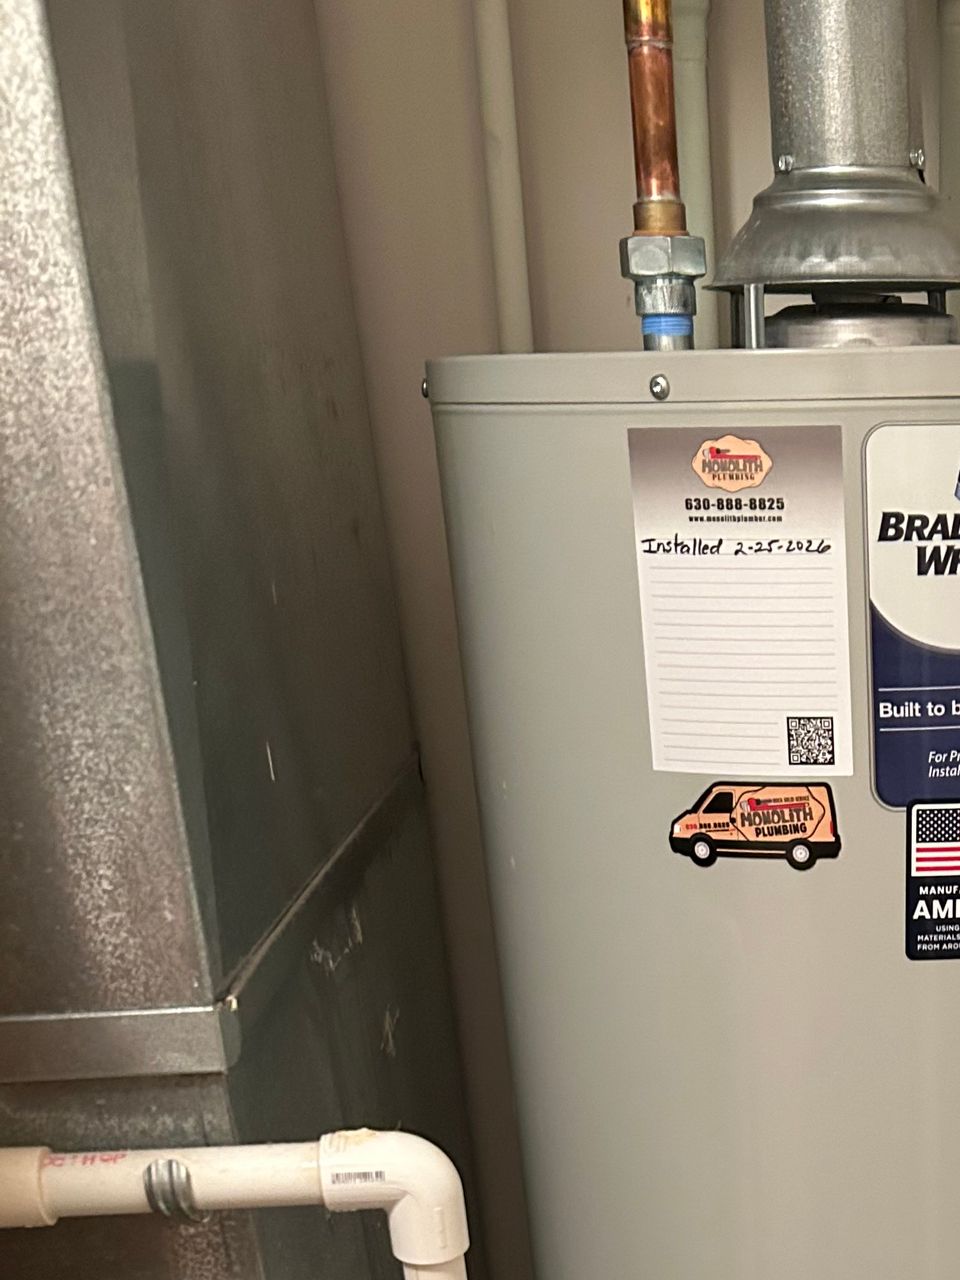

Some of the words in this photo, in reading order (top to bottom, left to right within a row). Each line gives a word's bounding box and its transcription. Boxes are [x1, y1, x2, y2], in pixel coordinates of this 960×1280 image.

[702, 458, 763, 473] MONOLITH
[712, 473, 755, 481] PLUMBING
[685, 498, 785, 511] 630-888-8825
[641, 533, 723, 556] Installed
[734, 539, 831, 556] 2-25-2026
[879, 702, 921, 718] Built
[927, 702, 945, 716] to
[928, 751, 947, 763] For
[741, 808, 813, 827] MONOLITH
[755, 823, 806, 837] PLUMBING
[917, 933, 960, 942] MATERIALS
